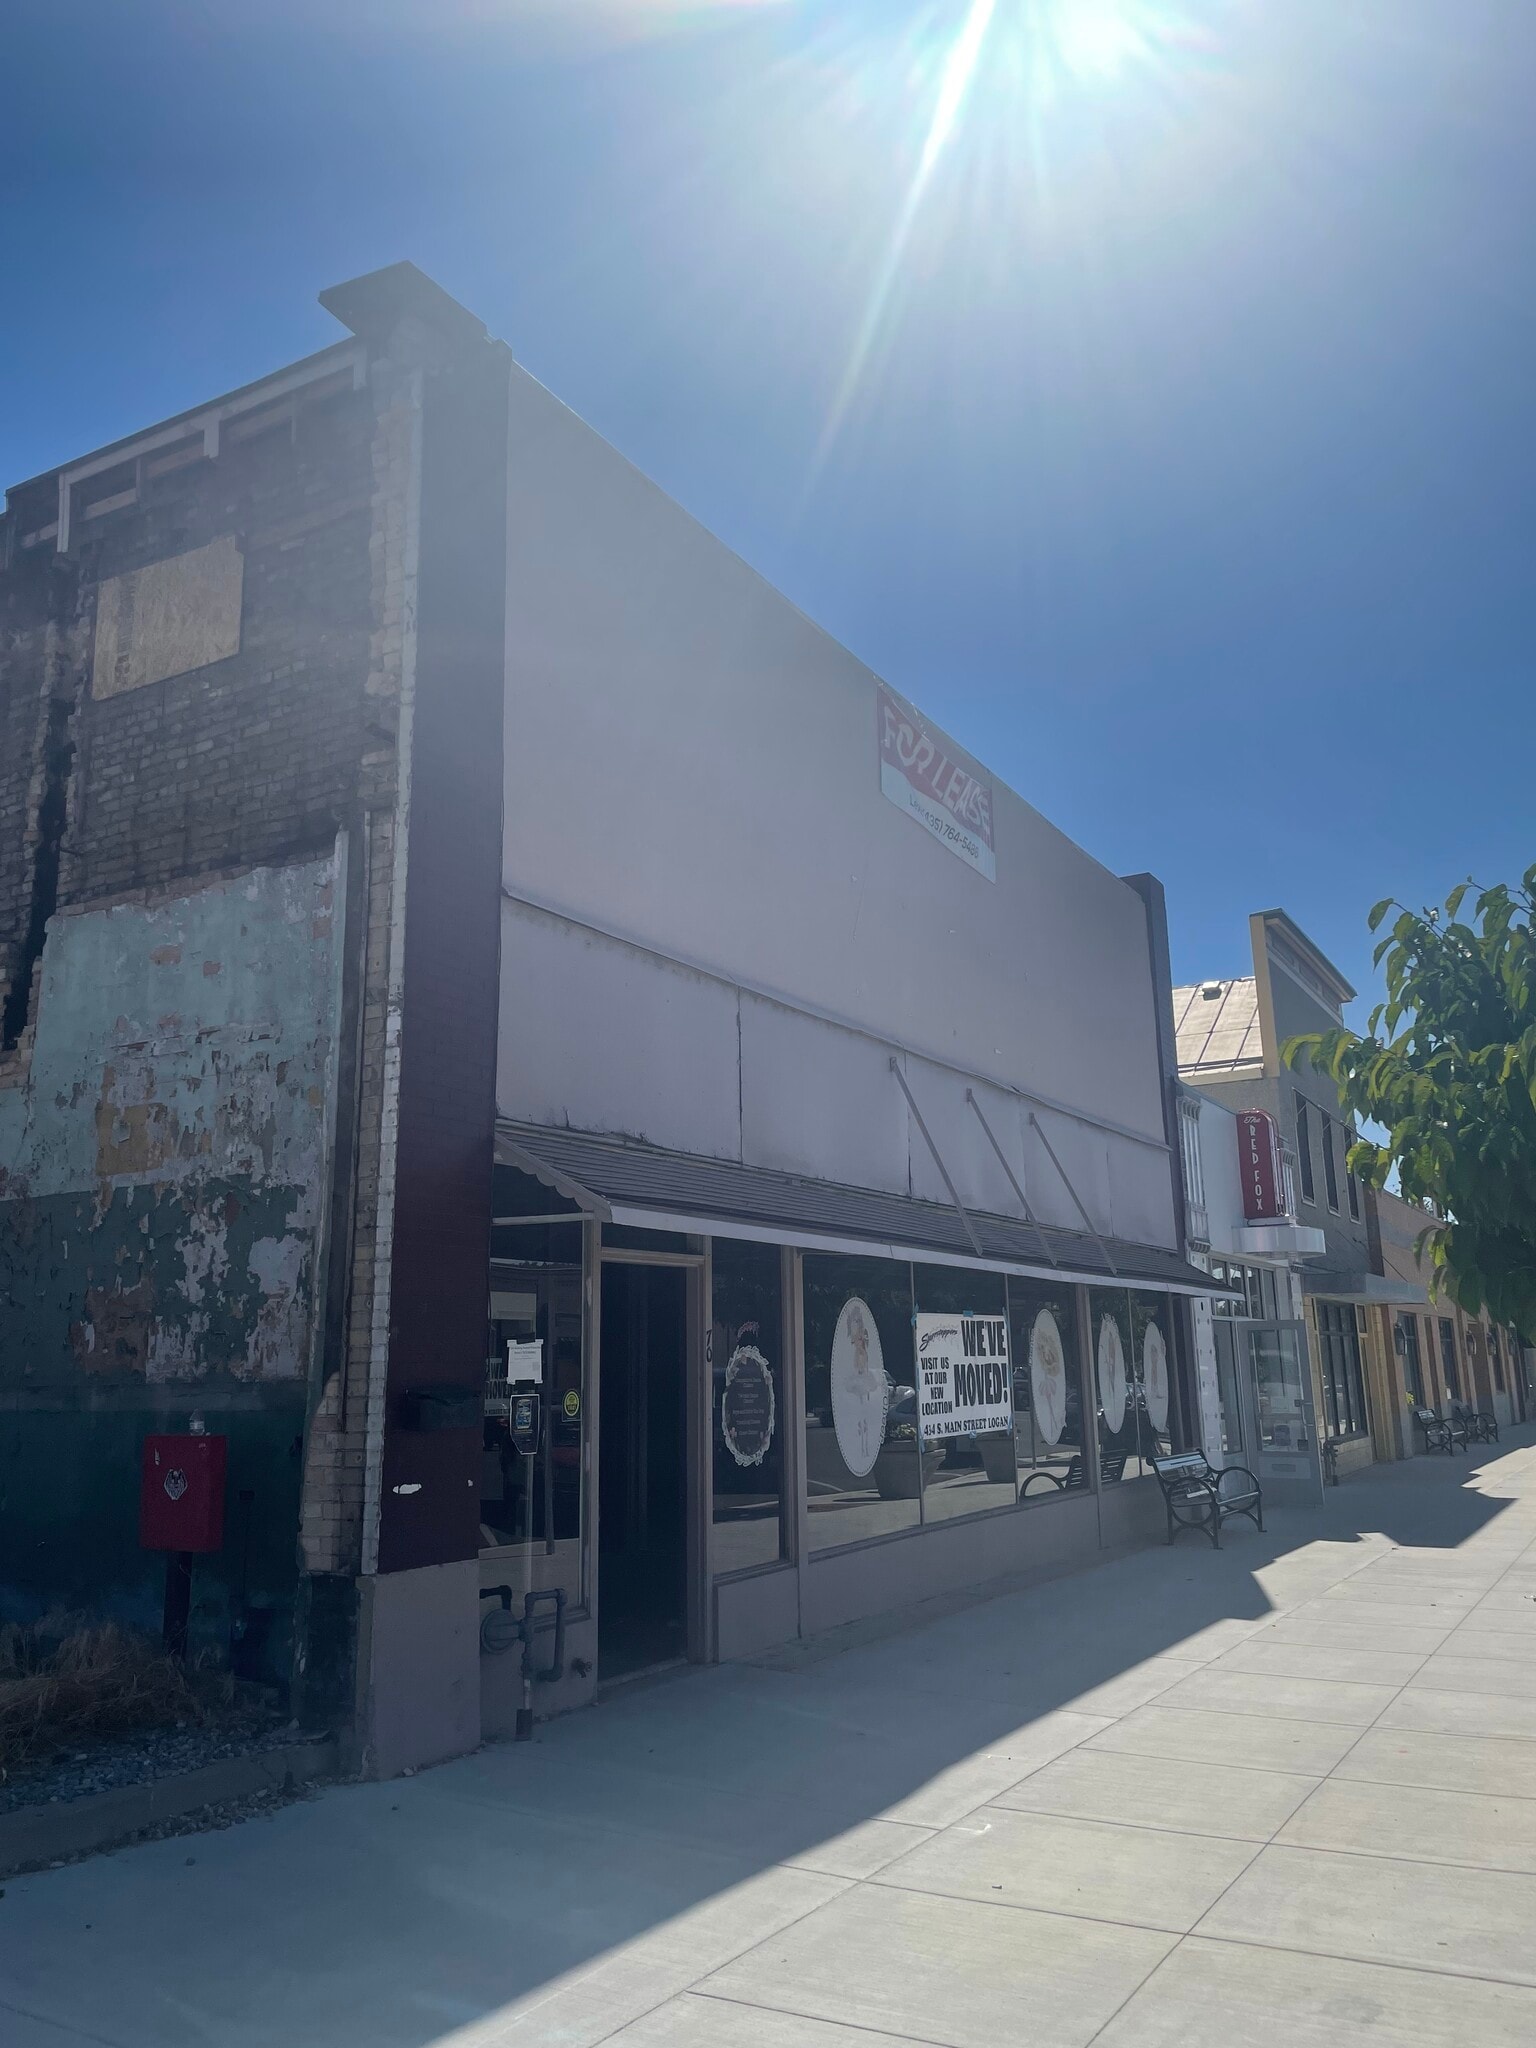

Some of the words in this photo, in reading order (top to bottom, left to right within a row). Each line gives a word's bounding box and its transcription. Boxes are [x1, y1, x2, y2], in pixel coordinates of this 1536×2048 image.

[1243, 1115, 1261, 1123] The
[1250, 1124, 1259, 1165] RED
[1254, 1170, 1263, 1211] FOX
[961, 1320, 1006, 1357] WE'VE
[921, 1357, 938, 1370] VISIT
[940, 1356, 949, 1369] US
[924, 1372, 934, 1385] AT
[935, 1371, 947, 1384] OUR
[953, 1363, 1008, 1407] MOVED!
[930, 1387, 944, 1400] NEW
[921, 1401, 953, 1416] LOCATION
[936, 1422, 944, 1434] S.
[944, 1420, 962, 1434] MAIN
[963, 1417, 987, 1432] STREET
[988, 1415, 1009, 1429] LOGAN
